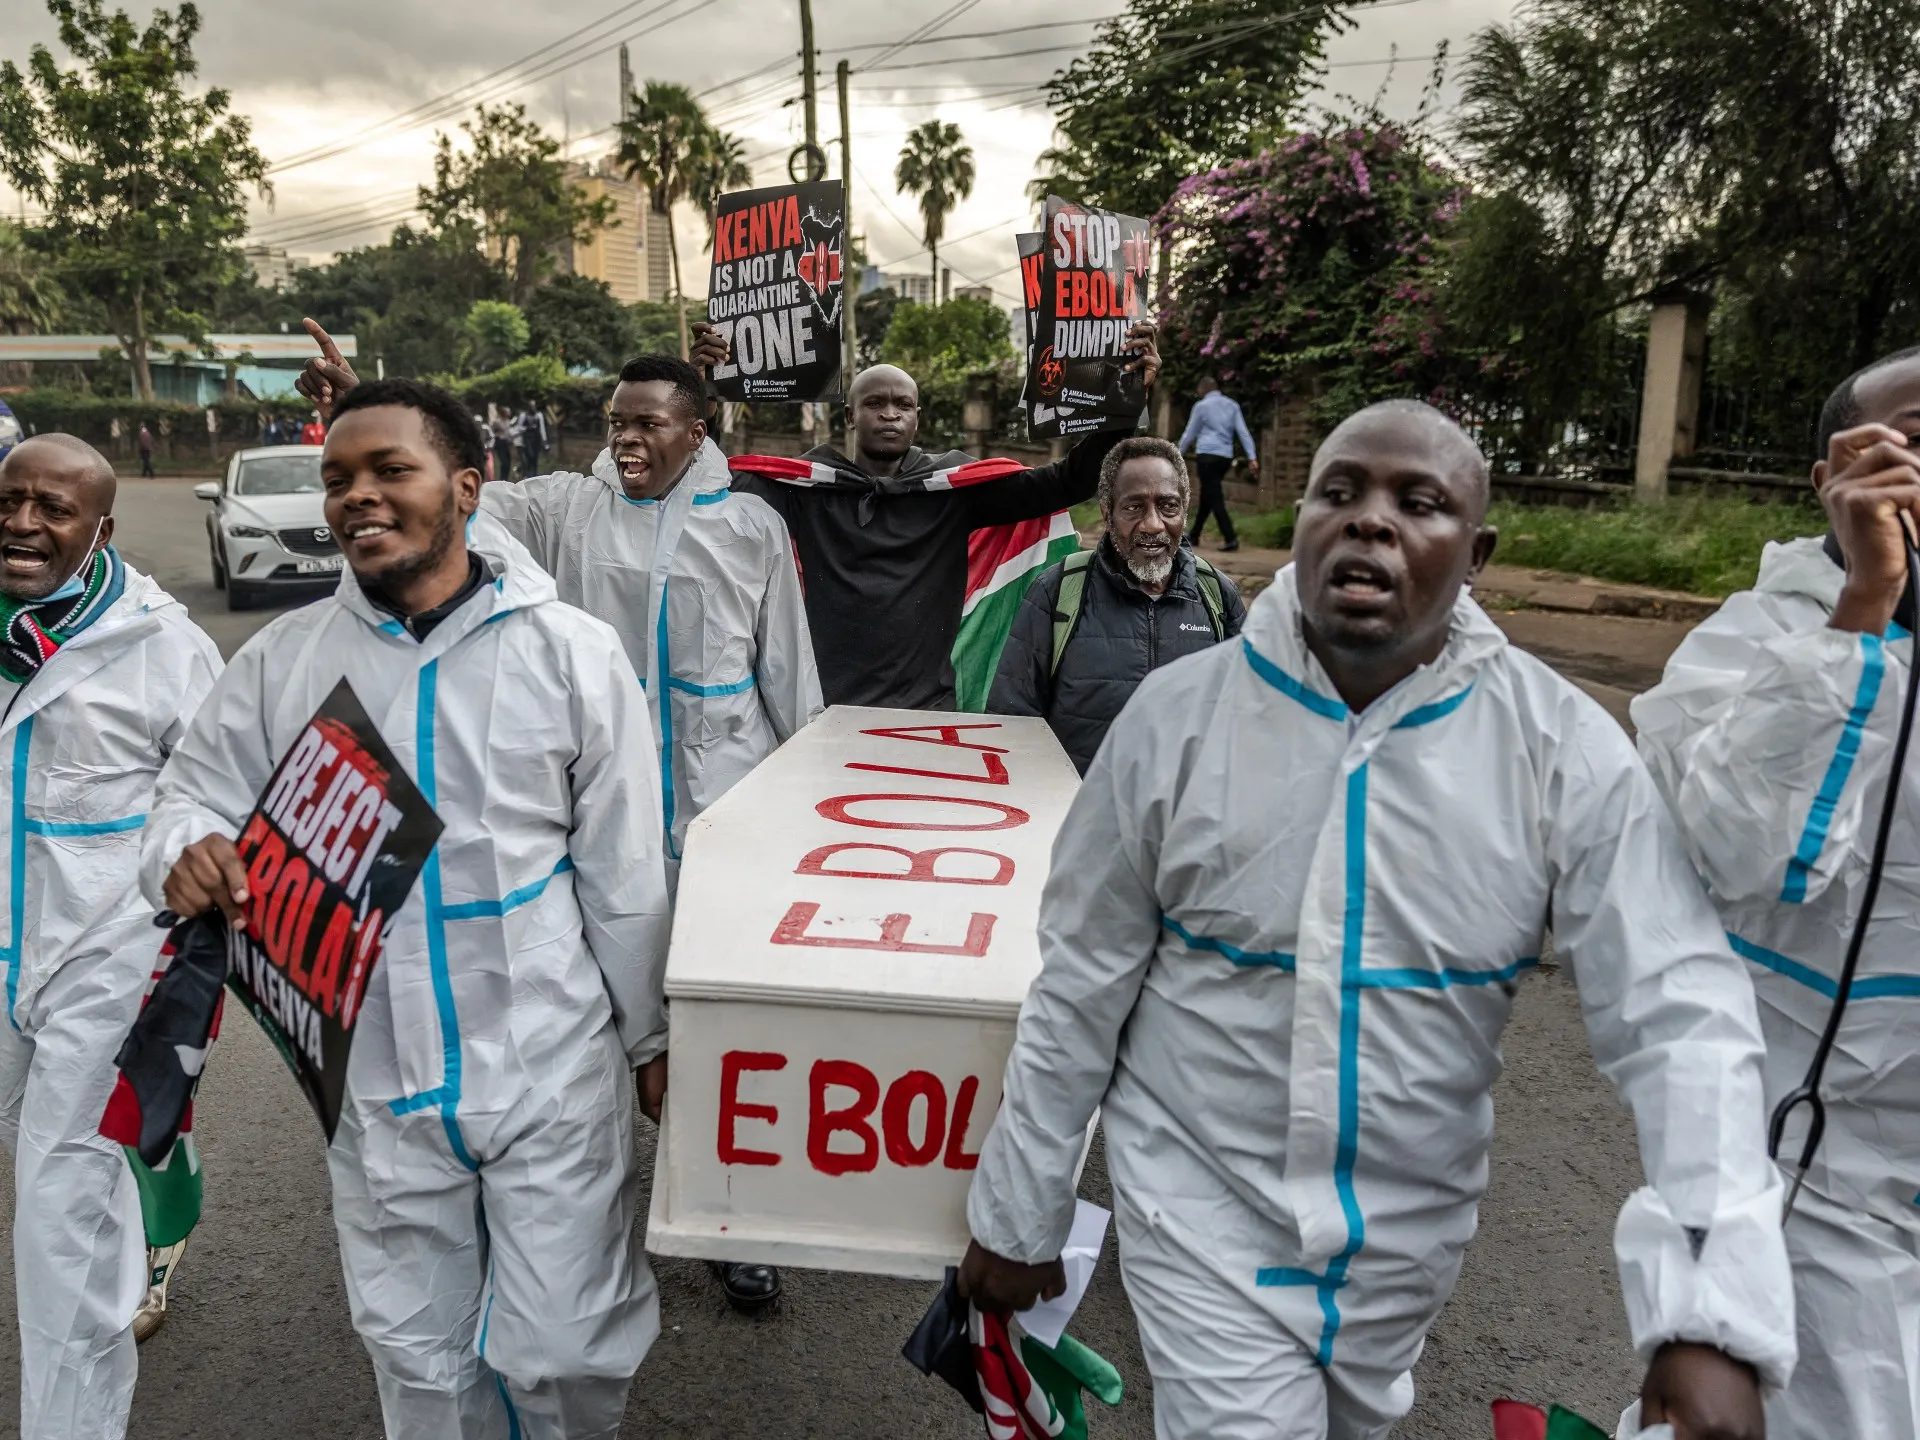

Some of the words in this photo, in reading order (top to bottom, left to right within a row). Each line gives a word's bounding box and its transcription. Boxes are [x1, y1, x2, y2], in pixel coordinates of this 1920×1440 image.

[715, 195, 802, 264] KENYA
[1053, 212, 1120, 269] STOP
[715, 264, 733, 293] IS
[738, 255, 777, 289] NOT
[782, 249, 796, 279] A
[1055, 271, 1138, 318] EBOLA
[709, 279, 800, 322] QUARANTINE
[713, 305, 817, 381] ZONE
[1053, 320, 1142, 359] DUMPIN
[1068, 389, 1083, 398] AMKA
[1067, 419, 1083, 427] AMKA
[1186, 623, 1210, 632] Columbia
[262, 725, 404, 900] REJECT
[770, 723, 1030, 957] EBOLA
[252, 945, 323, 1071] KENYA
[717, 1050, 1004, 1176] EBOL
